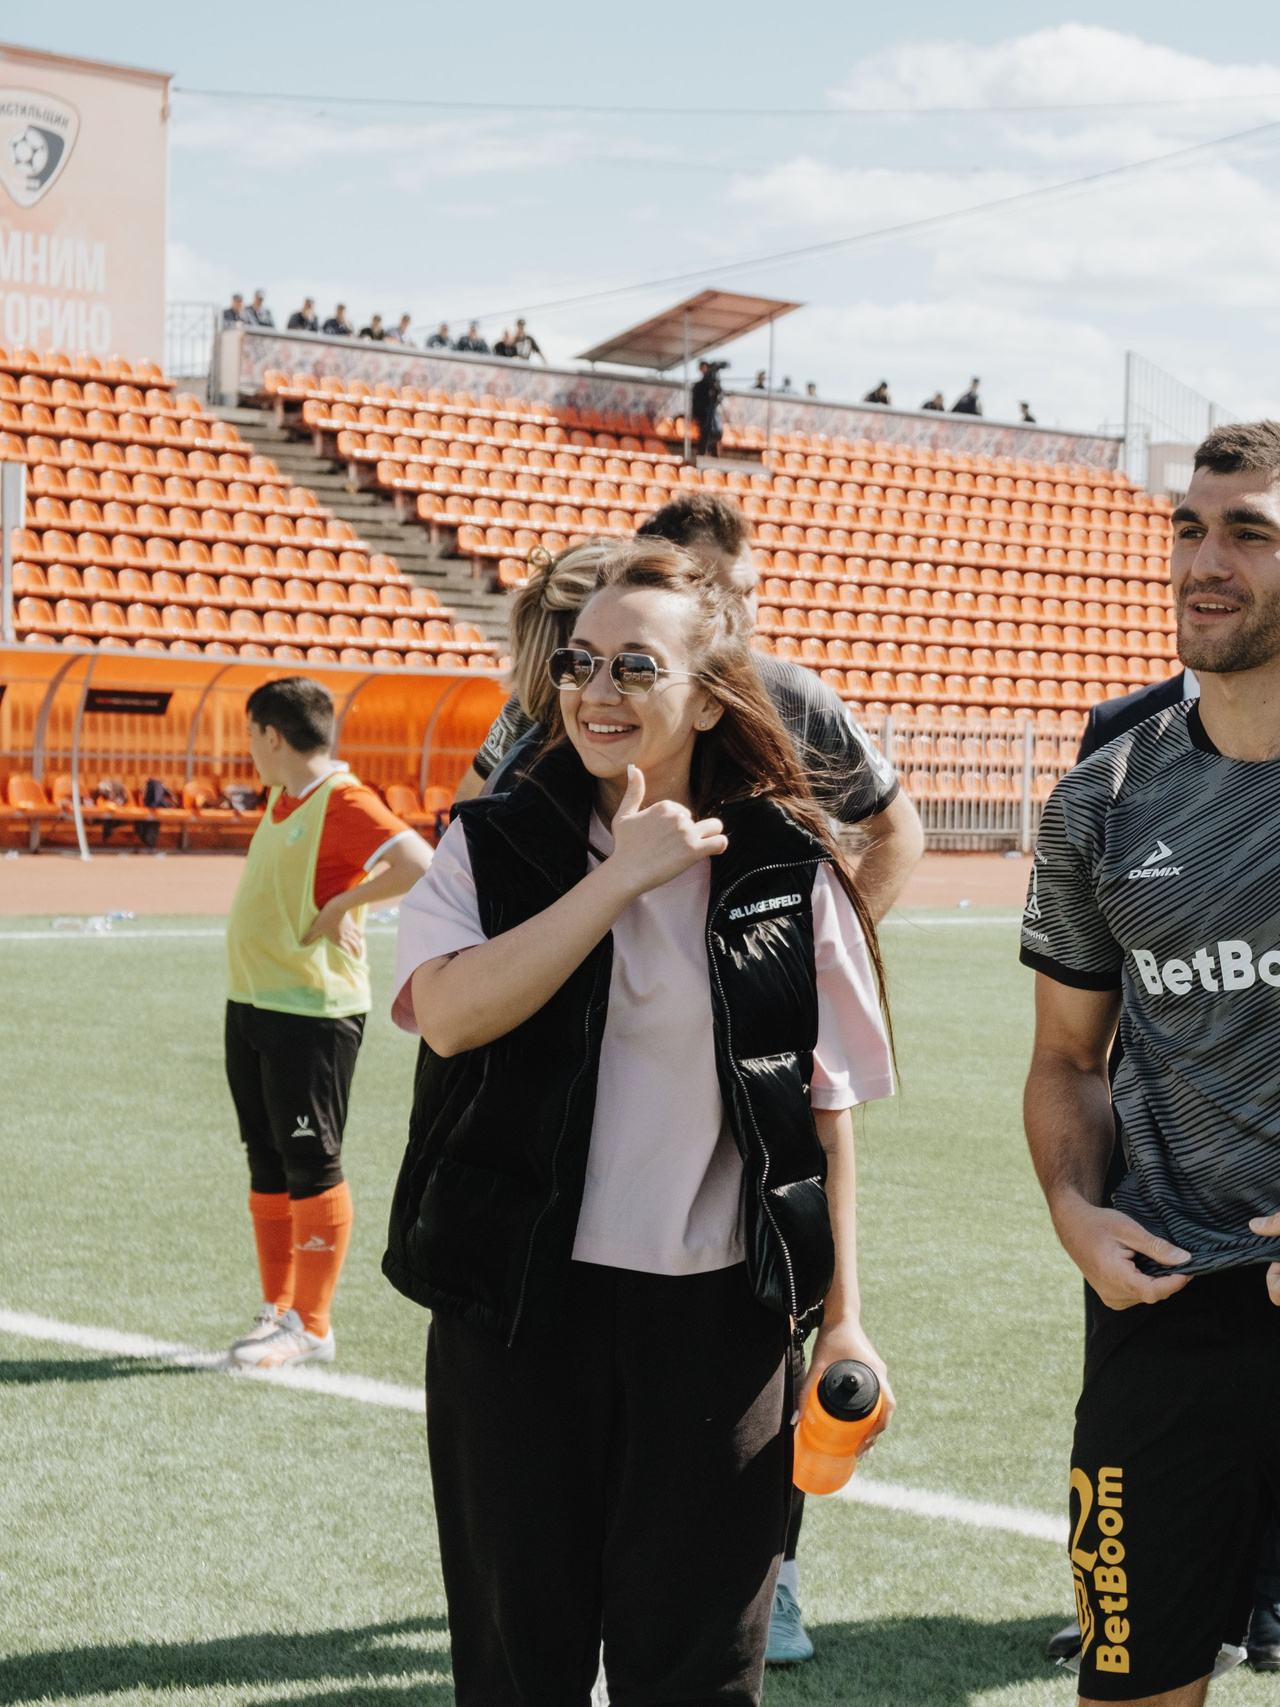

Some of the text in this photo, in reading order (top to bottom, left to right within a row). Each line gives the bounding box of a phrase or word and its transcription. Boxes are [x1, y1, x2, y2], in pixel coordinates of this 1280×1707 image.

[0, 289, 111, 354] ОРИЮ
[1128, 866, 1184, 880] DEMIX
[744, 893, 802, 915] LAGERFELD
[1094, 1466, 1130, 1674] BetBoom
